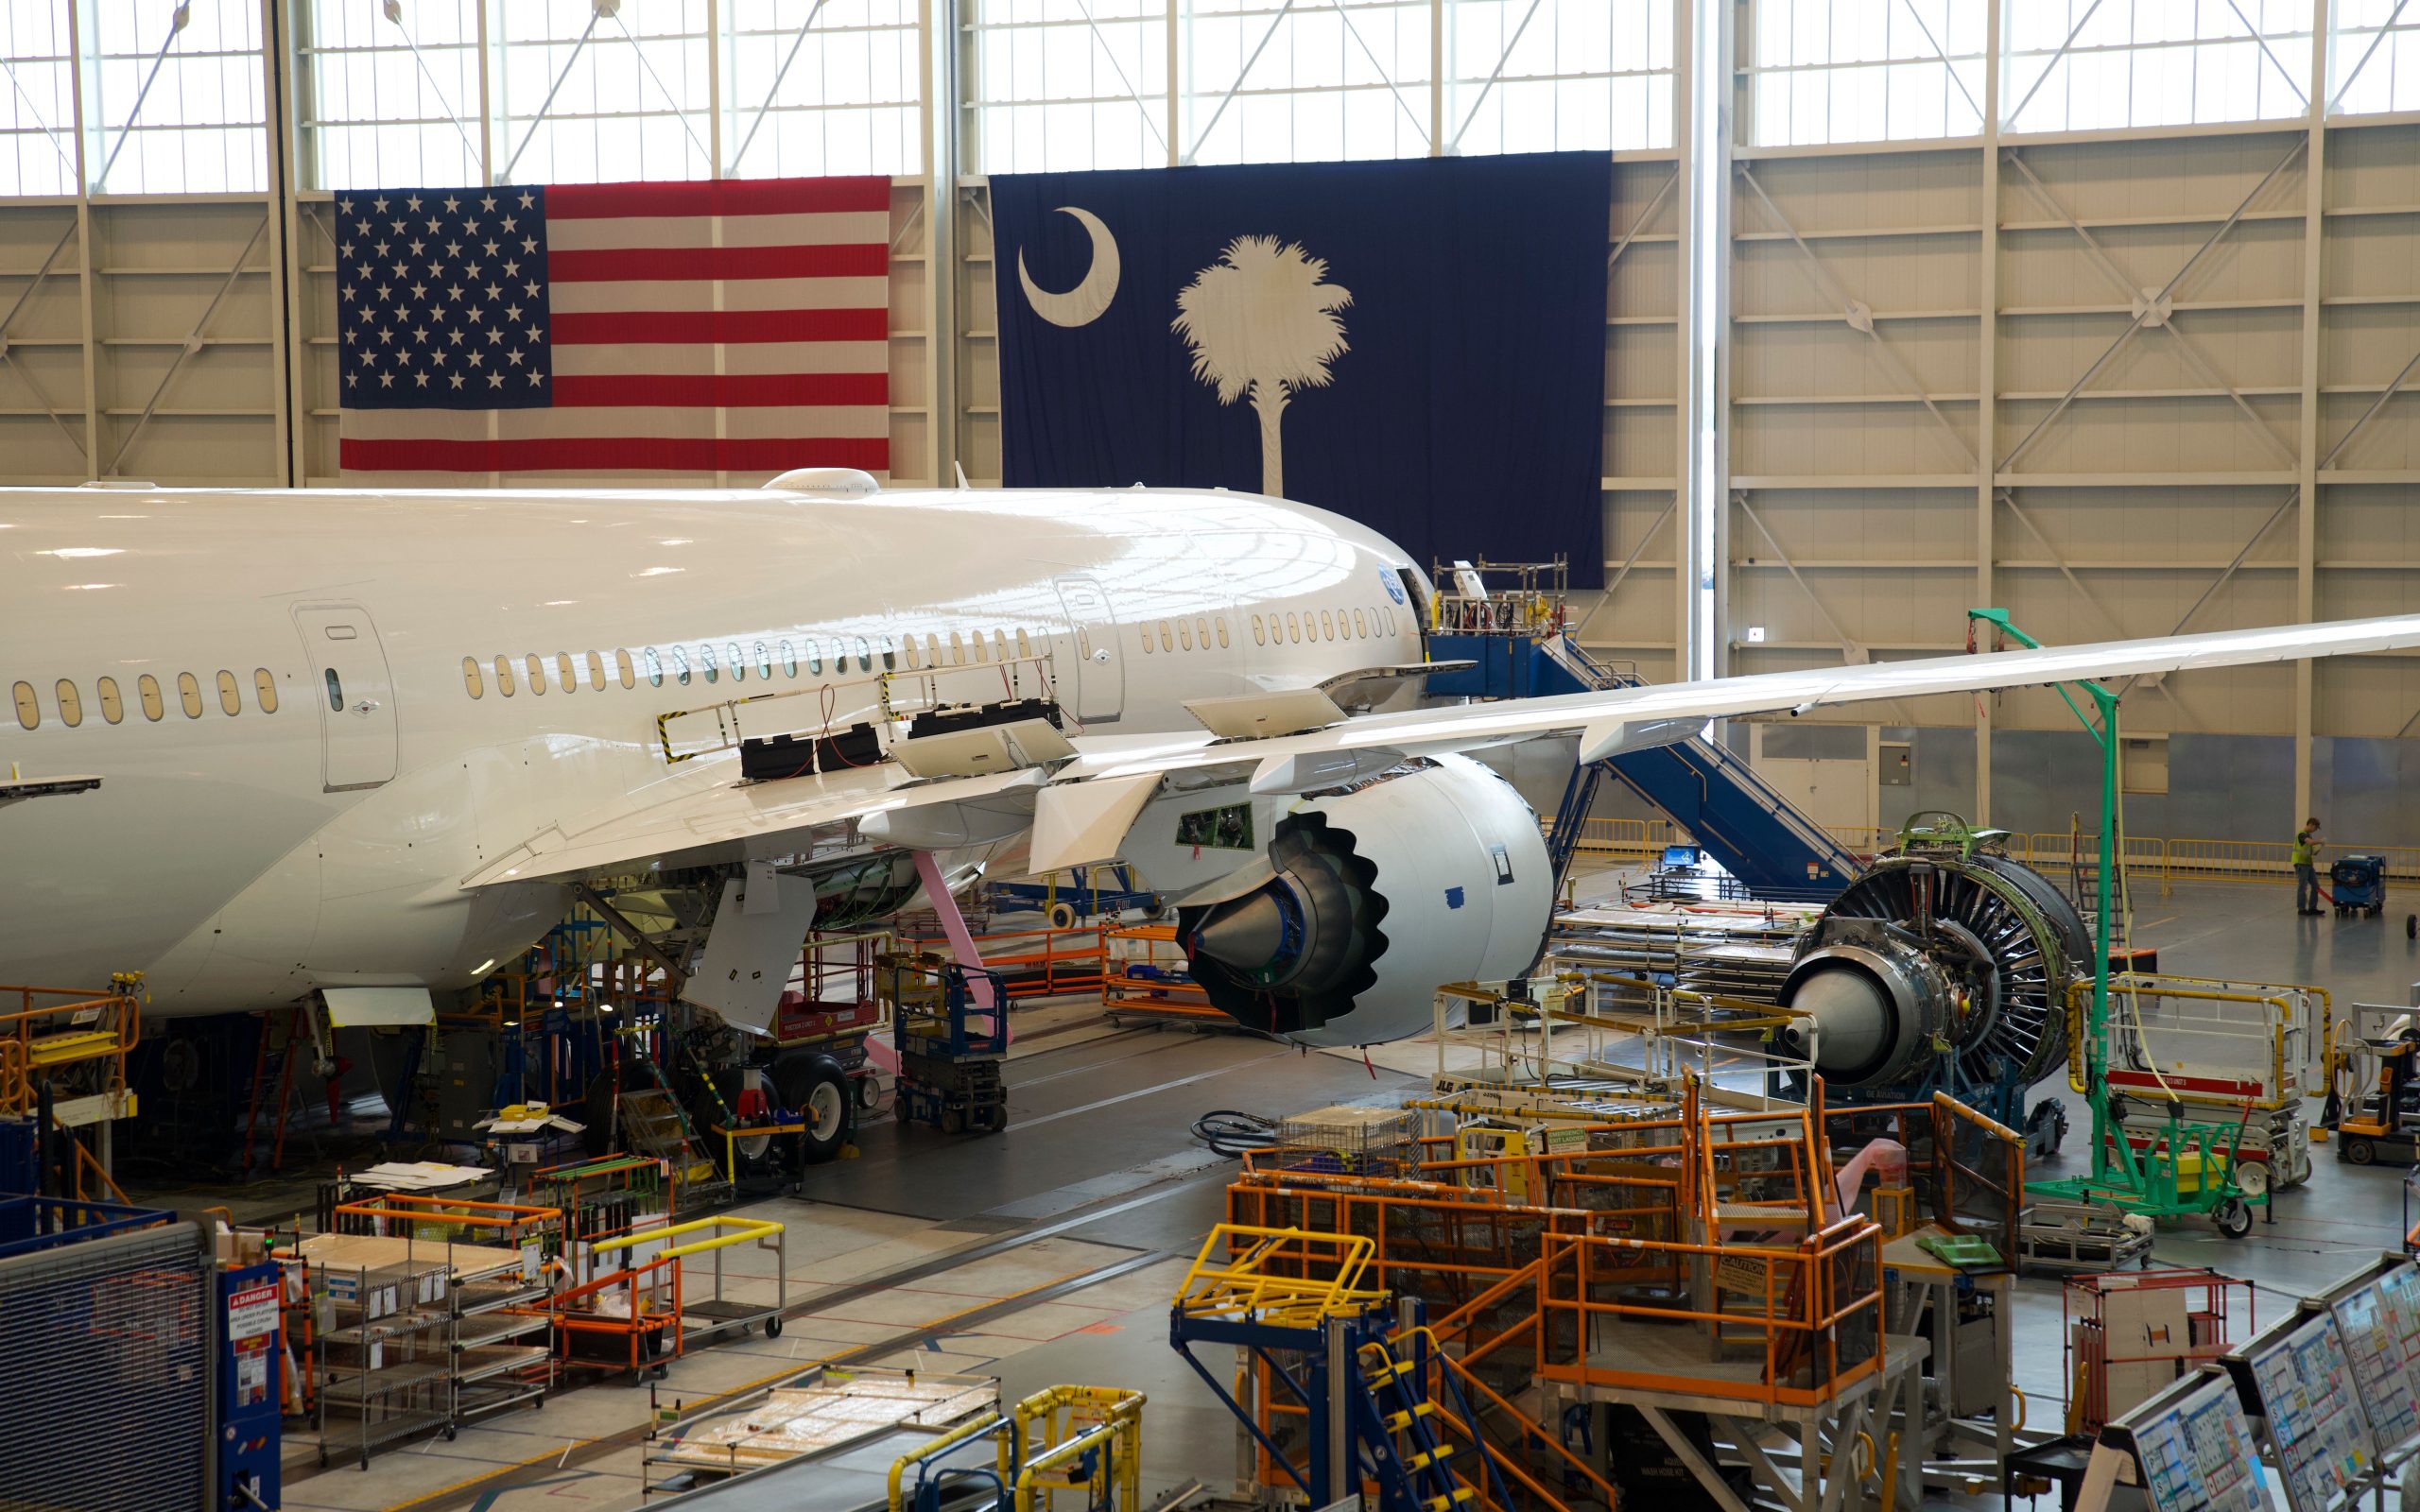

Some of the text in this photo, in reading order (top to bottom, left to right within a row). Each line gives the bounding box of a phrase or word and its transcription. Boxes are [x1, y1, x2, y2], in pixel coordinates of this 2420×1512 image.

[1436, 1080, 1454, 1093] JLG
[1722, 1256, 1765, 1276] CAUTION
[239, 1289, 272, 1304] DANGER
